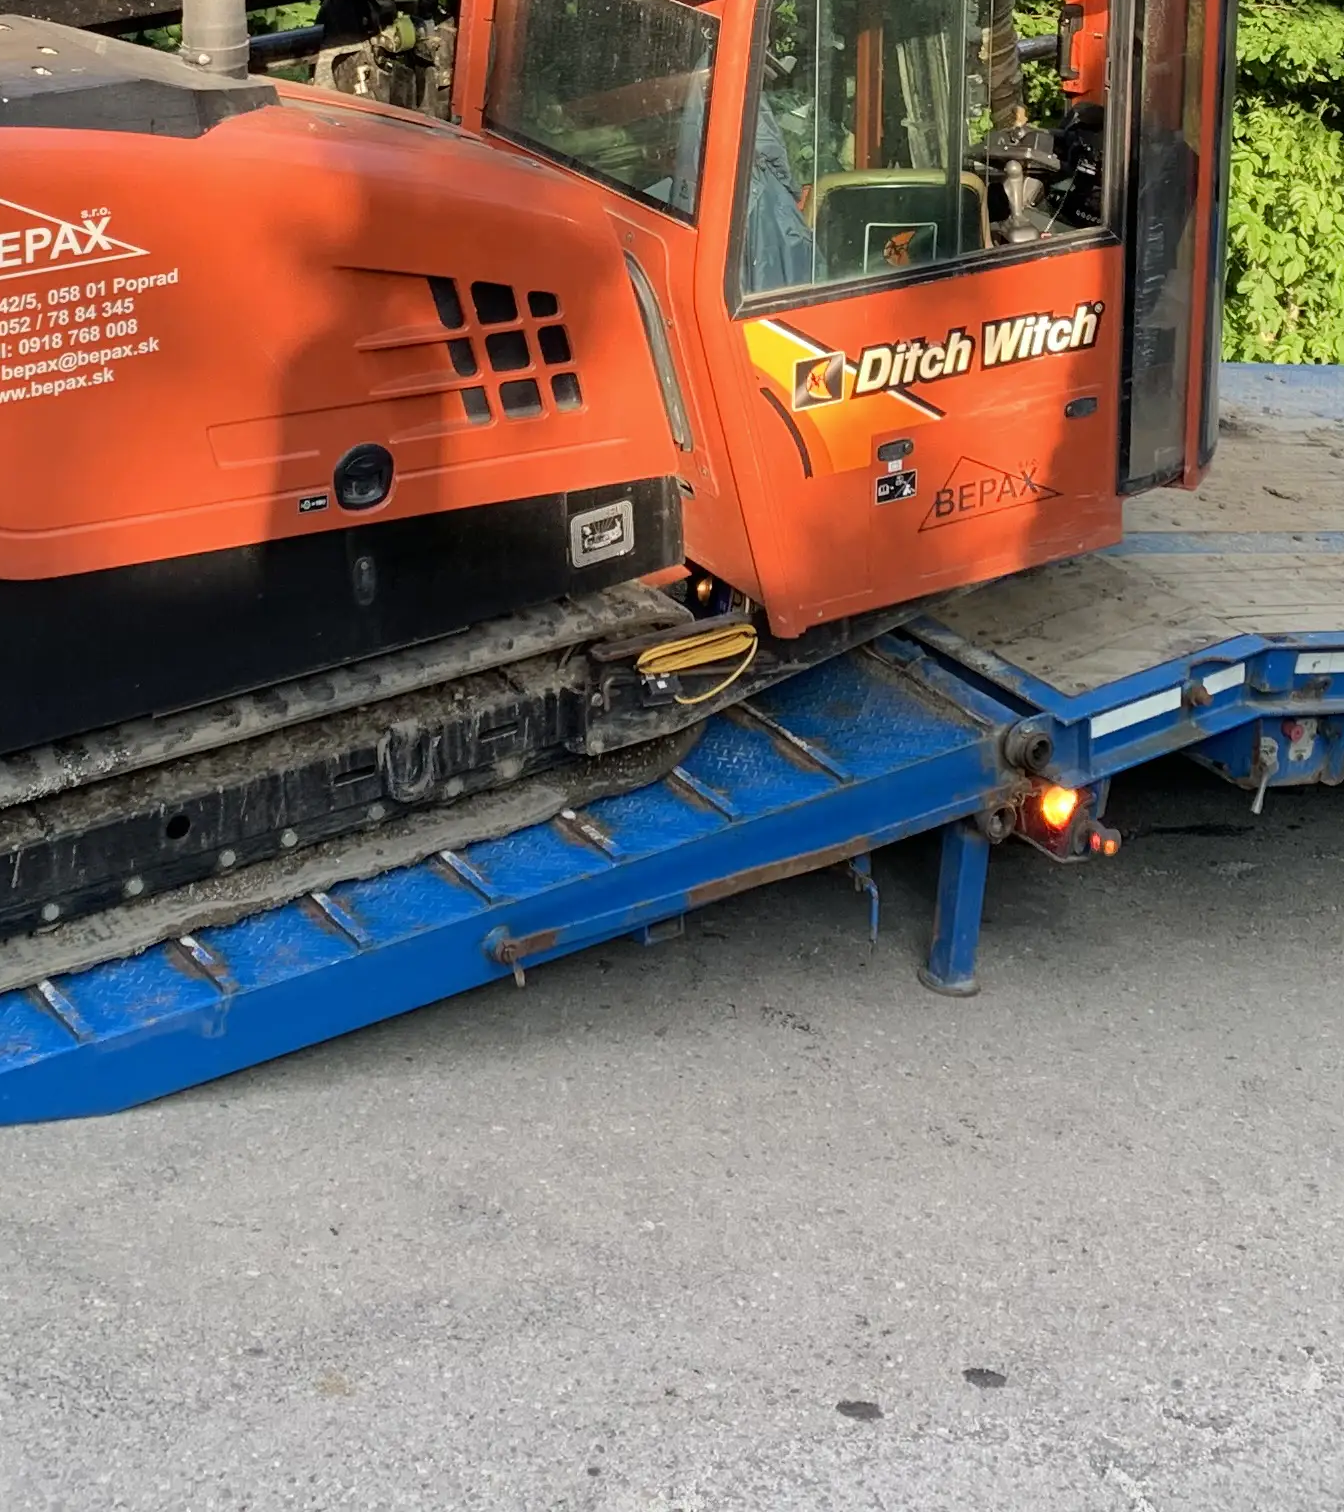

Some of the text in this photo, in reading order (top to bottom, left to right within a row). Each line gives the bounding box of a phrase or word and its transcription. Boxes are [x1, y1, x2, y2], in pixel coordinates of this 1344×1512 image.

[80, 206, 112, 219] s.r.o.
[47, 285, 81, 307] 058
[85, 280, 106, 299] 01
[113, 268, 179, 296] Poprad
[35, 314, 43, 331] /
[47, 308, 70, 329] 78
[74, 303, 97, 323] 84
[101, 297, 135, 318] 345
[18, 332, 63, 356] 0918
[68, 324, 101, 346] 768
[105, 319, 138, 339] 008
[1, 337, 160, 382] bepax@bepax.sk
[855, 330, 974, 394] Ditch
[935, 466, 1040, 518] BEPAX
